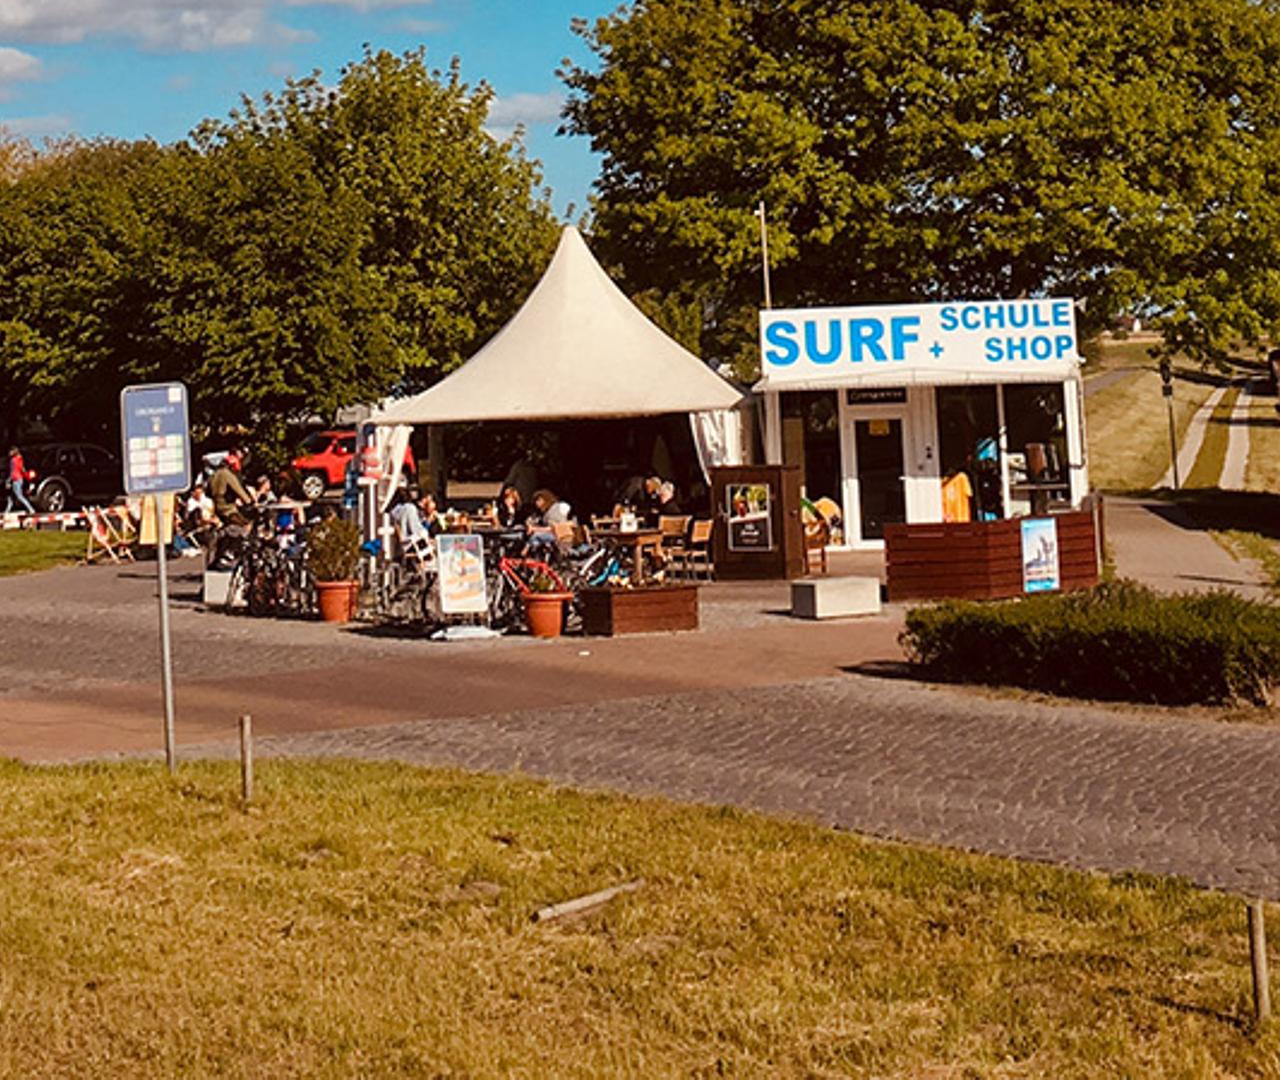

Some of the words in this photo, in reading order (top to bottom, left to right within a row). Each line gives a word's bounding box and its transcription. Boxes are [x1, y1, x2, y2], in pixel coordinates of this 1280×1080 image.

[940, 302, 1069, 331] SCHULE
[765, 317, 921, 366] SURF
[986, 335, 1073, 362] SHOP
